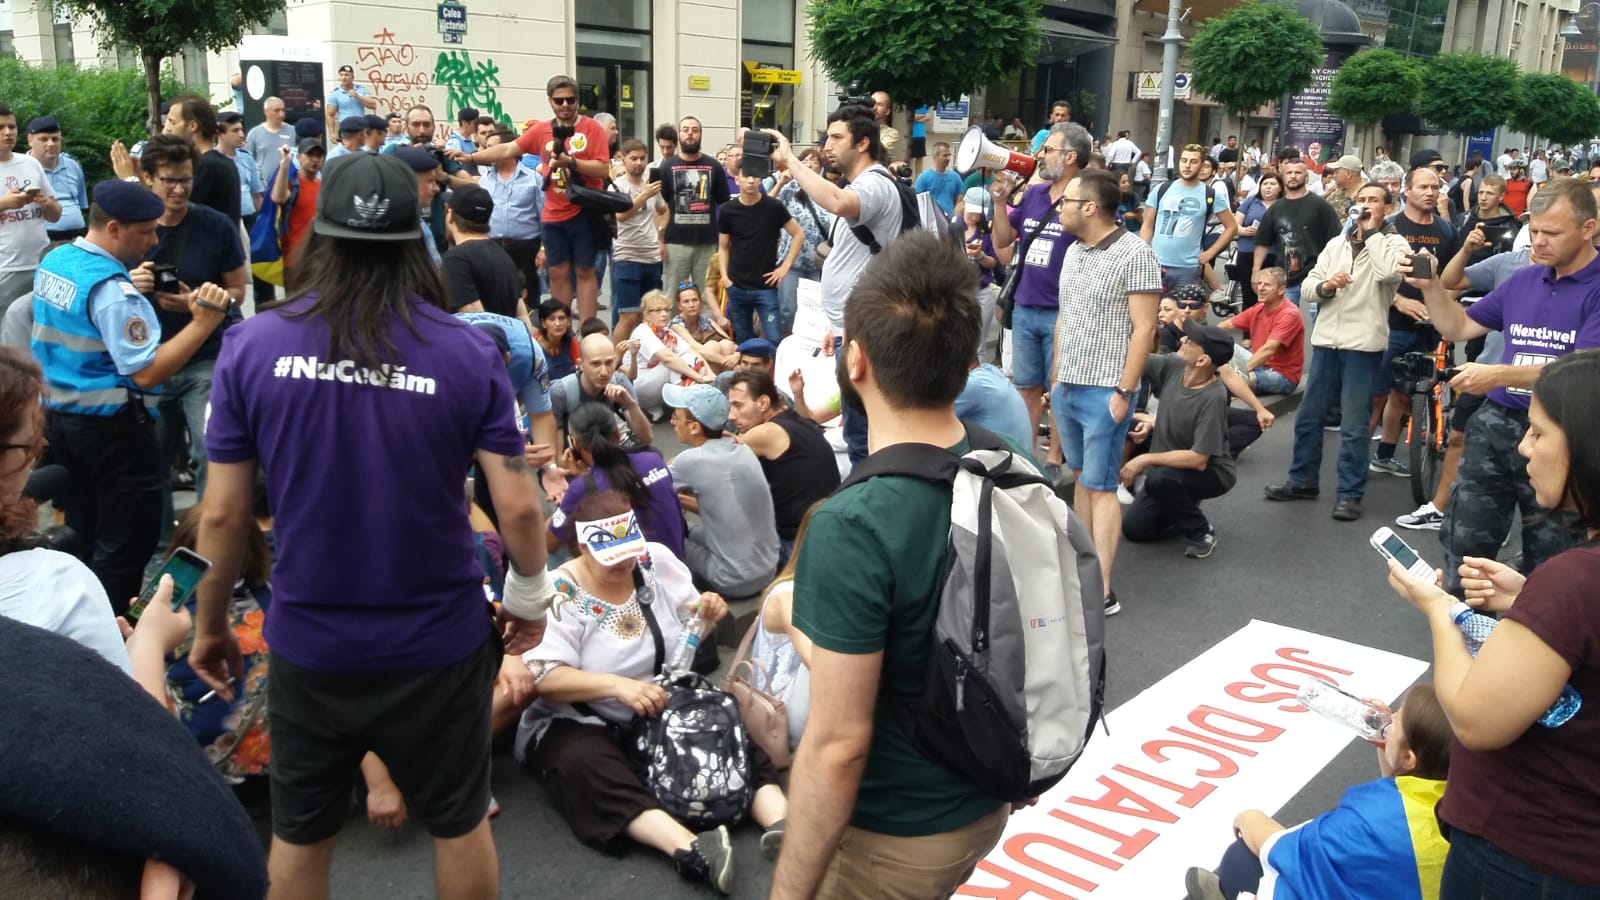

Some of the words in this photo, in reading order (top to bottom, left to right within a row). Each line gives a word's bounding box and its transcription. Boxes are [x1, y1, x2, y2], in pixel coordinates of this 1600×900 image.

[443, 7, 462, 18] Calea
[440, 19, 467, 32] Victoriei
[1223, 647, 1354, 714] JOS
